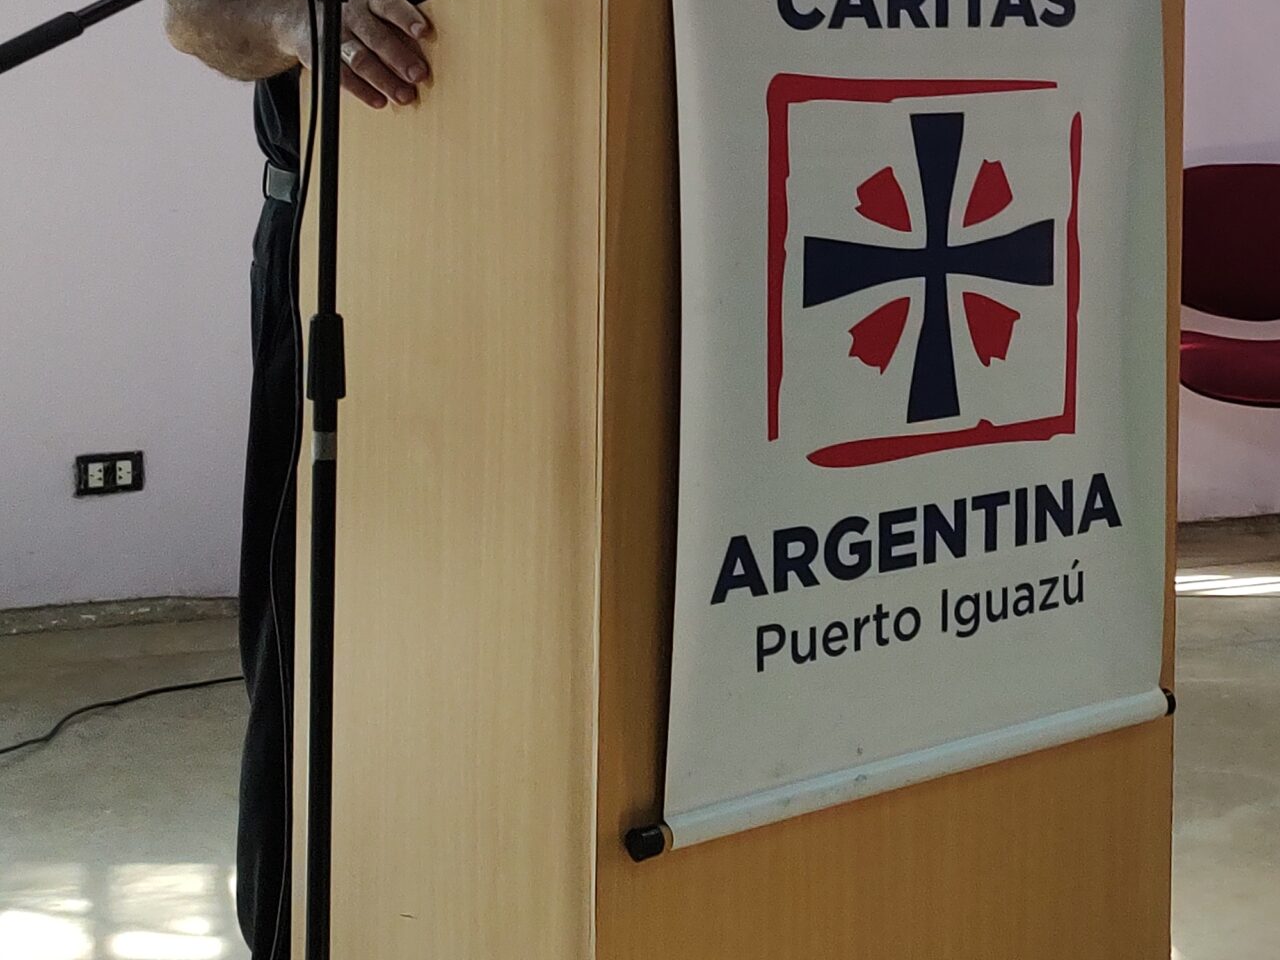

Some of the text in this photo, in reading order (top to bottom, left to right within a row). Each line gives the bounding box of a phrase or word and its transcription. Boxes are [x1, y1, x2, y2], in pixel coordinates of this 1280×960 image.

[710, 472, 1122, 606] ARGENTINA
[755, 559, 1086, 673] Puerto Iguazú
